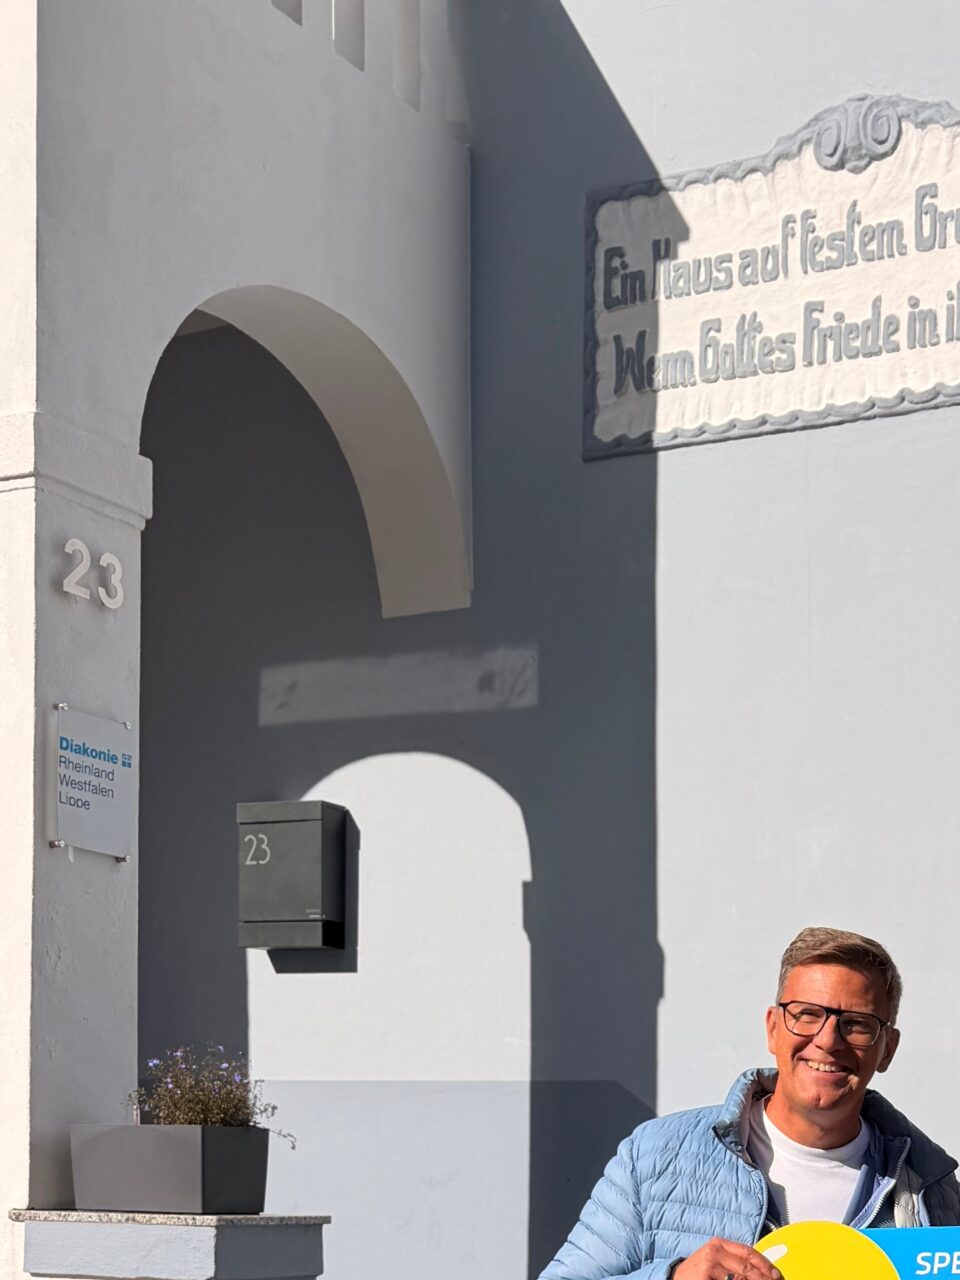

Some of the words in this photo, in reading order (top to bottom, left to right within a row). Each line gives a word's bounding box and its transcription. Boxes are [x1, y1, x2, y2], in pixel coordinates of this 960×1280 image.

[603, 245, 647, 312] Ein
[651, 237, 733, 300] Haus
[738, 214, 797, 287] auf
[700, 311, 796, 384] Gottes
[803, 295, 901, 367] Friede
[907, 295, 940, 350] in
[63, 538, 125, 609] 23
[59, 735, 119, 765] Diakonie
[59, 755, 115, 781] Rheinland
[59, 772, 114, 799] Westfalen
[244, 834, 271, 865] 23
